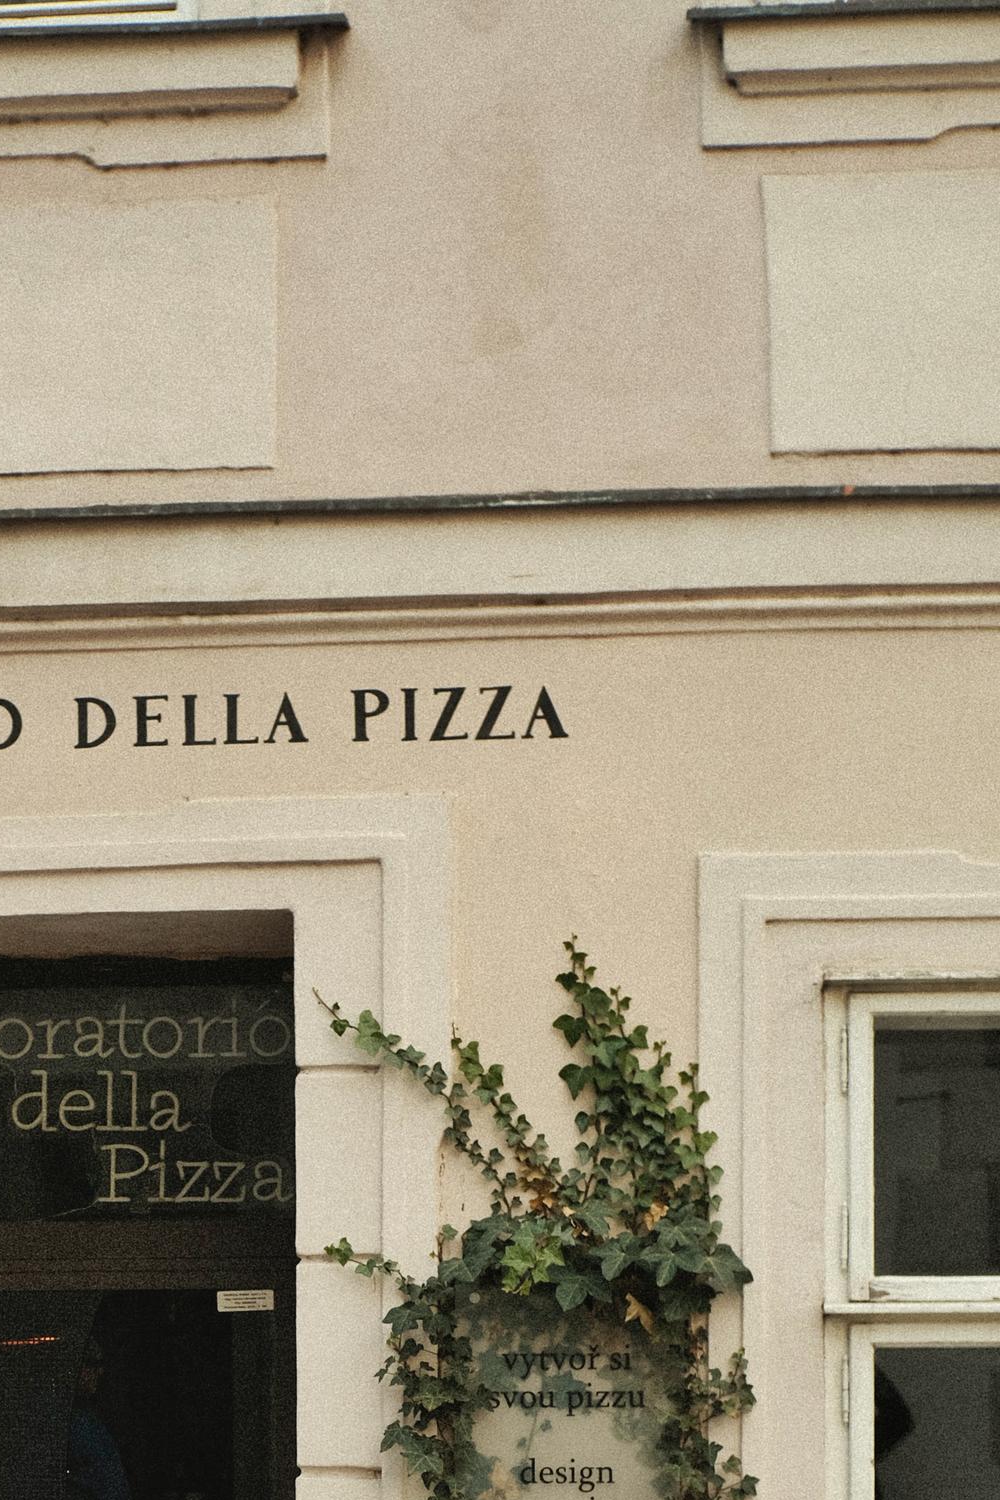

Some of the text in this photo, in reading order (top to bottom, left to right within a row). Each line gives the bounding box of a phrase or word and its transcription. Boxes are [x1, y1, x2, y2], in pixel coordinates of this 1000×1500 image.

[74, 691, 309, 749] DELLA
[350, 684, 570, 743] PIZZA
[11, 1069, 191, 1132] della
[96, 1139, 295, 1203] Pizza
[502, 1344, 632, 1380] vytvoř si
[489, 1382, 646, 1417] svou pizzu
[519, 1458, 615, 1493] design
